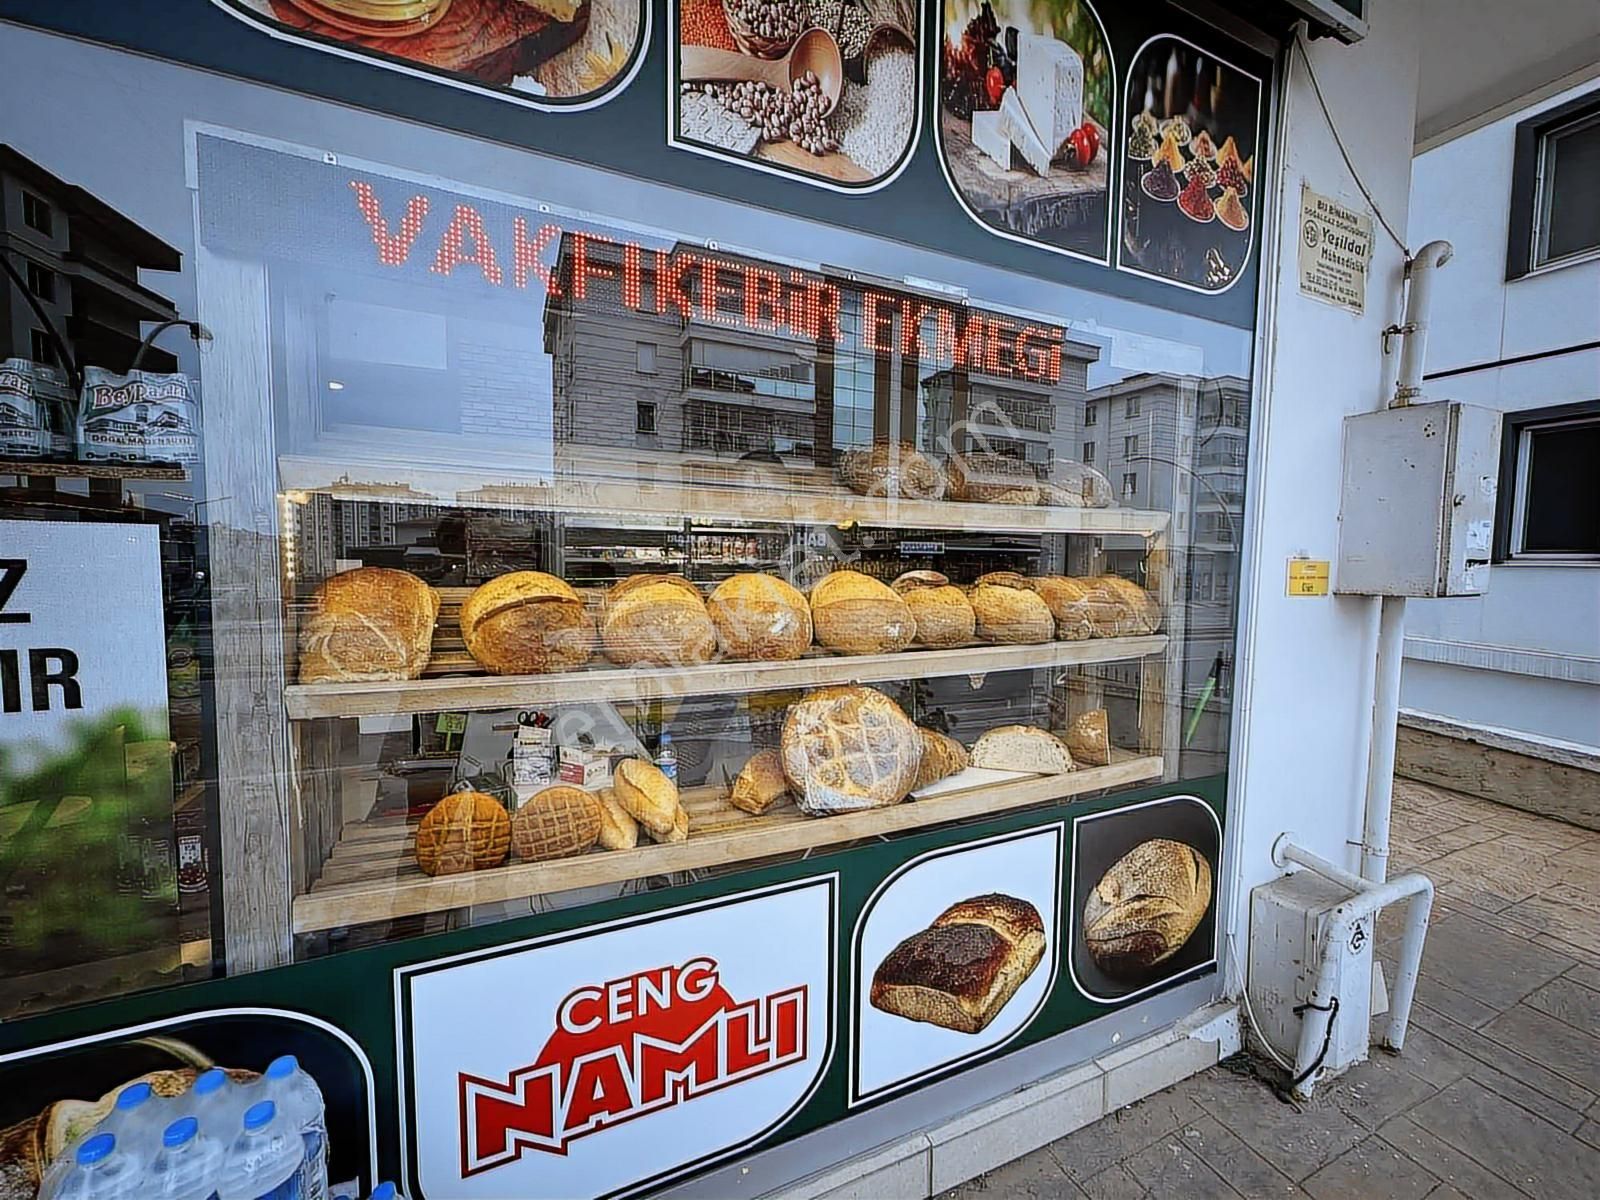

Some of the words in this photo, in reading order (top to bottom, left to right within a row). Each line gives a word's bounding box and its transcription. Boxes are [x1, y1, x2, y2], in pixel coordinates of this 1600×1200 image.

[1321, 226, 1367, 258] Yeşildal
[558, 958, 718, 1035] CENG
[459, 986, 808, 1179] NAMLI
